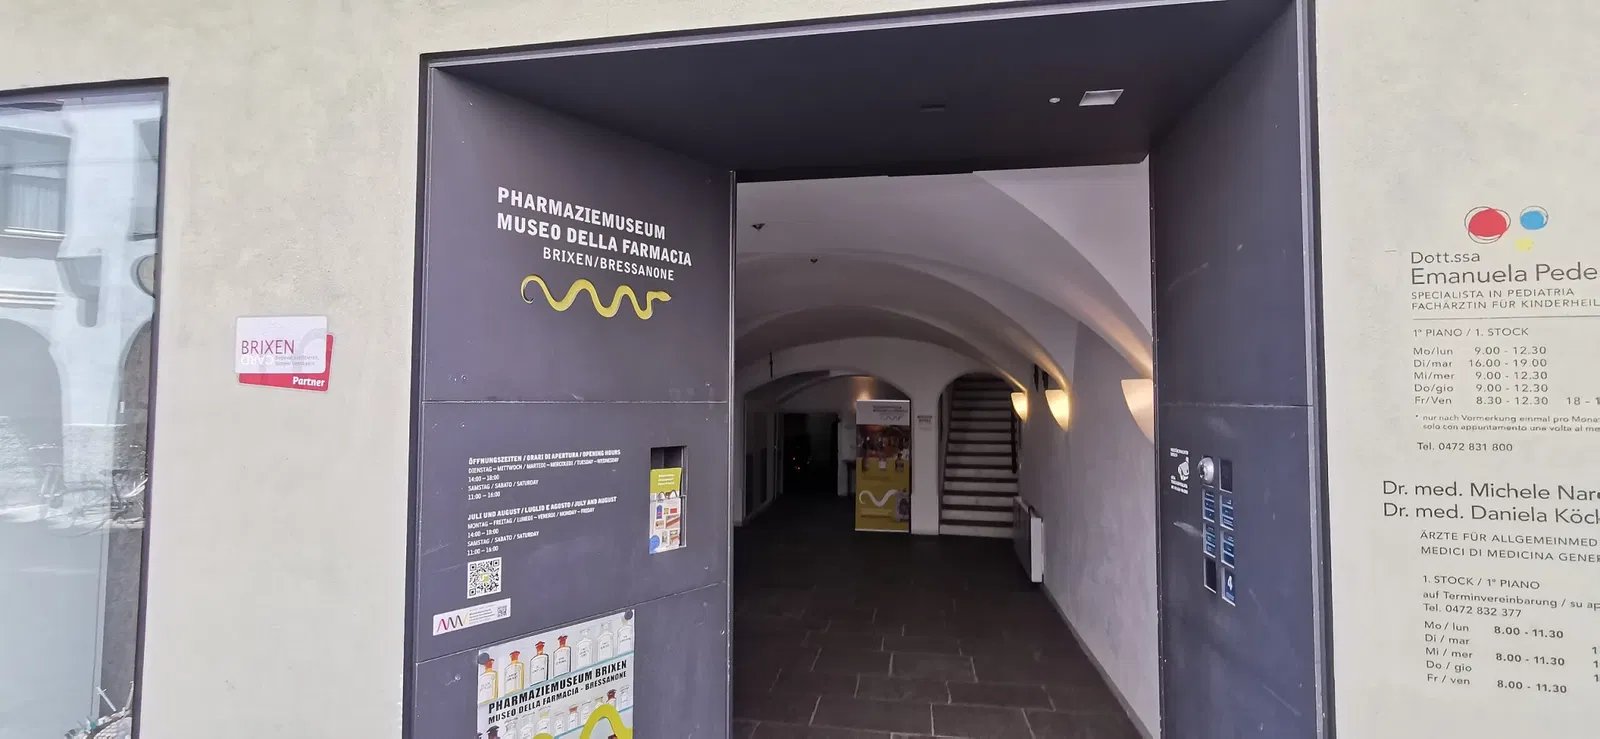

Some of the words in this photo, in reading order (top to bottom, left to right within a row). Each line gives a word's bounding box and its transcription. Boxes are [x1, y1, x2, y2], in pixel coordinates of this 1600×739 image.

[498, 187, 665, 240] PHARMAZIEMUSEUM
[497, 213, 561, 240] MUSEO
[567, 228, 618, 252] DELLA
[622, 239, 692, 266] FARMACIA
[543, 247, 674, 281] BRIXEN/BRESSANONE
[1411, 252, 1480, 264] Dott.ssa
[1411, 264, 1527, 285] Emanuela
[1536, 262, 1598, 282] Pede
[1411, 290, 1484, 300] SPECIALISTA
[1489, 290, 1502, 298] IN
[1508, 288, 1575, 297] PEDIATRIA
[1412, 301, 1487, 310] FACHÄRZTIN
[1492, 299, 1516, 309] FÜR
[1521, 299, 1600, 308] KINDERHEIL
[1426, 329, 1463, 337] PIANO
[1476, 328, 1484, 336] 1.
[1488, 328, 1529, 336] STOCK
[241, 340, 295, 355] BRIXEN
[1413, 347, 1453, 355] Mo/lun
[1474, 347, 1500, 355] 9.00
[1513, 347, 1547, 355] 12.30
[1414, 360, 1452, 368] Di/mar
[1469, 359, 1501, 367] 16.00
[1514, 359, 1547, 367] 19.00
[292, 376, 325, 387] Partner
[1414, 372, 1455, 380] Mi/mer
[1475, 372, 1501, 380] 9.00
[1514, 372, 1548, 380] 12.30
[1414, 384, 1454, 394] Do/gio
[1476, 384, 1502, 392] 9.00
[1515, 384, 1548, 392] 12.30
[1415, 397, 1452, 405] Fr/Ven
[1476, 397, 1502, 405] 8.30
[1515, 397, 1548, 405] 12.30
[1567, 397, 1581, 405] 18
[1461, 415, 1517, 423] Vormerkung
[1417, 442, 1434, 450] Tel.
[1439, 443, 1465, 451] 0472
[1468, 443, 1487, 451] 831
[1492, 443, 1513, 451] 800
[469, 456, 522, 465] ÖFFNUNGSZEITEN
[527, 454, 544, 462] ORARI
[468, 466, 492, 474] DIENSTAG
[497, 464, 522, 472] MITTWOCH
[468, 484, 490, 492] SAMSTAG
[1383, 481, 1408, 495] Dr.
[1415, 482, 1462, 497] med.
[1470, 483, 1550, 500] Michele
[468, 513, 482, 521] JULI
[498, 508, 521, 517] AUGUST
[525, 505, 545, 513] LUGLIO
[551, 502, 570, 510] AGOSTO
[575, 500, 586, 508] JULY
[587, 498, 598, 506] AND
[598, 496, 617, 504] AUGUST
[1384, 503, 1409, 517] Dr.
[1416, 504, 1464, 519] med.
[1472, 505, 1547, 522] Daniela
[468, 522, 488, 530] MONTAG
[494, 518, 513, 526] FREITAG
[581, 507, 595, 515] FRIDAY
[467, 538, 489, 547] SAMSTAG
[495, 535, 512, 543] SABATO
[517, 531, 539, 539] SATURDAY
[1420, 530, 1458, 541] ÄRZTE
[1463, 532, 1487, 542] FÜR
[1492, 534, 1598, 547] ALLGEMEINMED
[1421, 546, 1464, 556] MEDICI
[1470, 548, 1482, 557] DI
[1487, 550, 1554, 561] MEDICINA
[1434, 576, 1474, 586] STOCK
[1487, 579, 1496, 587] 1°
[1500, 580, 1540, 590] PIANO
[1423, 591, 1439, 599] auf
[1443, 591, 1558, 609] Terminvereinbarung
[1423, 603, 1441, 612] Tel.
[1446, 605, 1473, 614] 0472
[1476, 607, 1497, 616] 832
[1502, 609, 1522, 617] 377
[1424, 621, 1442, 630] Mo
[1453, 623, 1469, 632] lun
[1494, 626, 1520, 636] 8.00
[1532, 629, 1563, 639] 11.30
[1425, 634, 1437, 642] Di
[1426, 647, 1439, 656] Mi
[1452, 651, 1473, 659] mer
[1496, 653, 1521, 662] 8.00
[1534, 656, 1565, 666] 11.30
[1426, 661, 1442, 669] Do
[1455, 664, 1472, 673] gio
[488, 670, 593, 714] PHARMAZIEMUSEUM
[596, 660, 627, 677] BRIXEN
[1428, 674, 1438, 682] Fr
[1497, 680, 1523, 689] 8.00
[1536, 684, 1567, 693] 11.30
[489, 709, 516, 724] MUSEO
[519, 701, 541, 714] DELLA
[543, 687, 579, 708] FARMACIA
[585, 671, 627, 691] BRESSANONE
